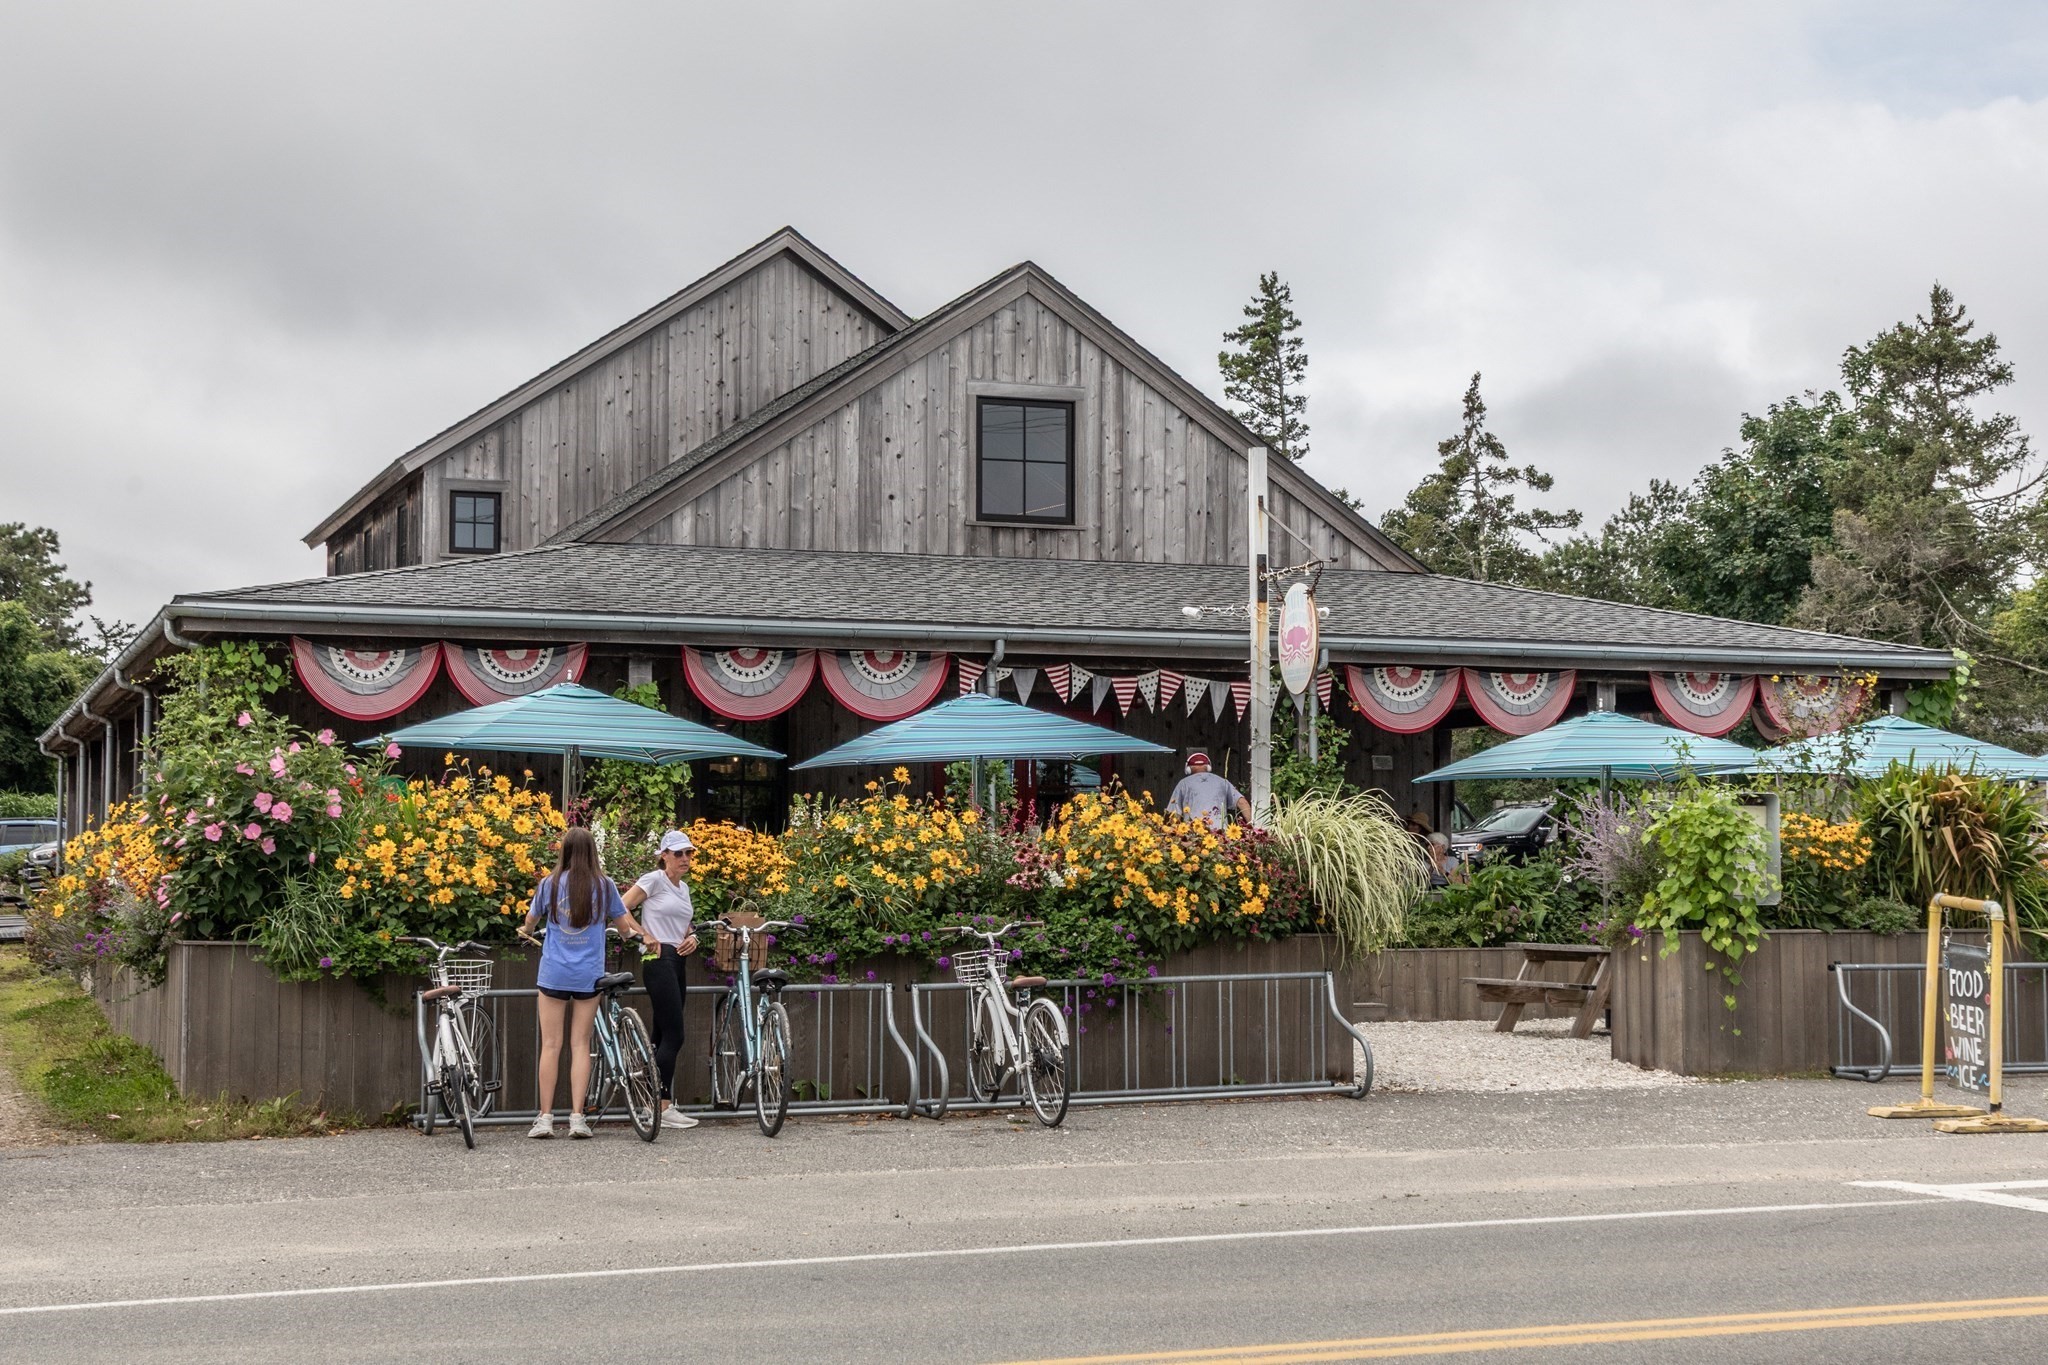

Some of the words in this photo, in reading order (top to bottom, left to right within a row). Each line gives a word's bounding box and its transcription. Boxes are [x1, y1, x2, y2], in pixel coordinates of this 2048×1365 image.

[1949, 968, 1983, 998] FOOD
[1950, 1003, 1985, 1037] BEER
[1950, 1036, 1984, 1066] WINE
[1958, 1065, 1979, 1090] ICE
